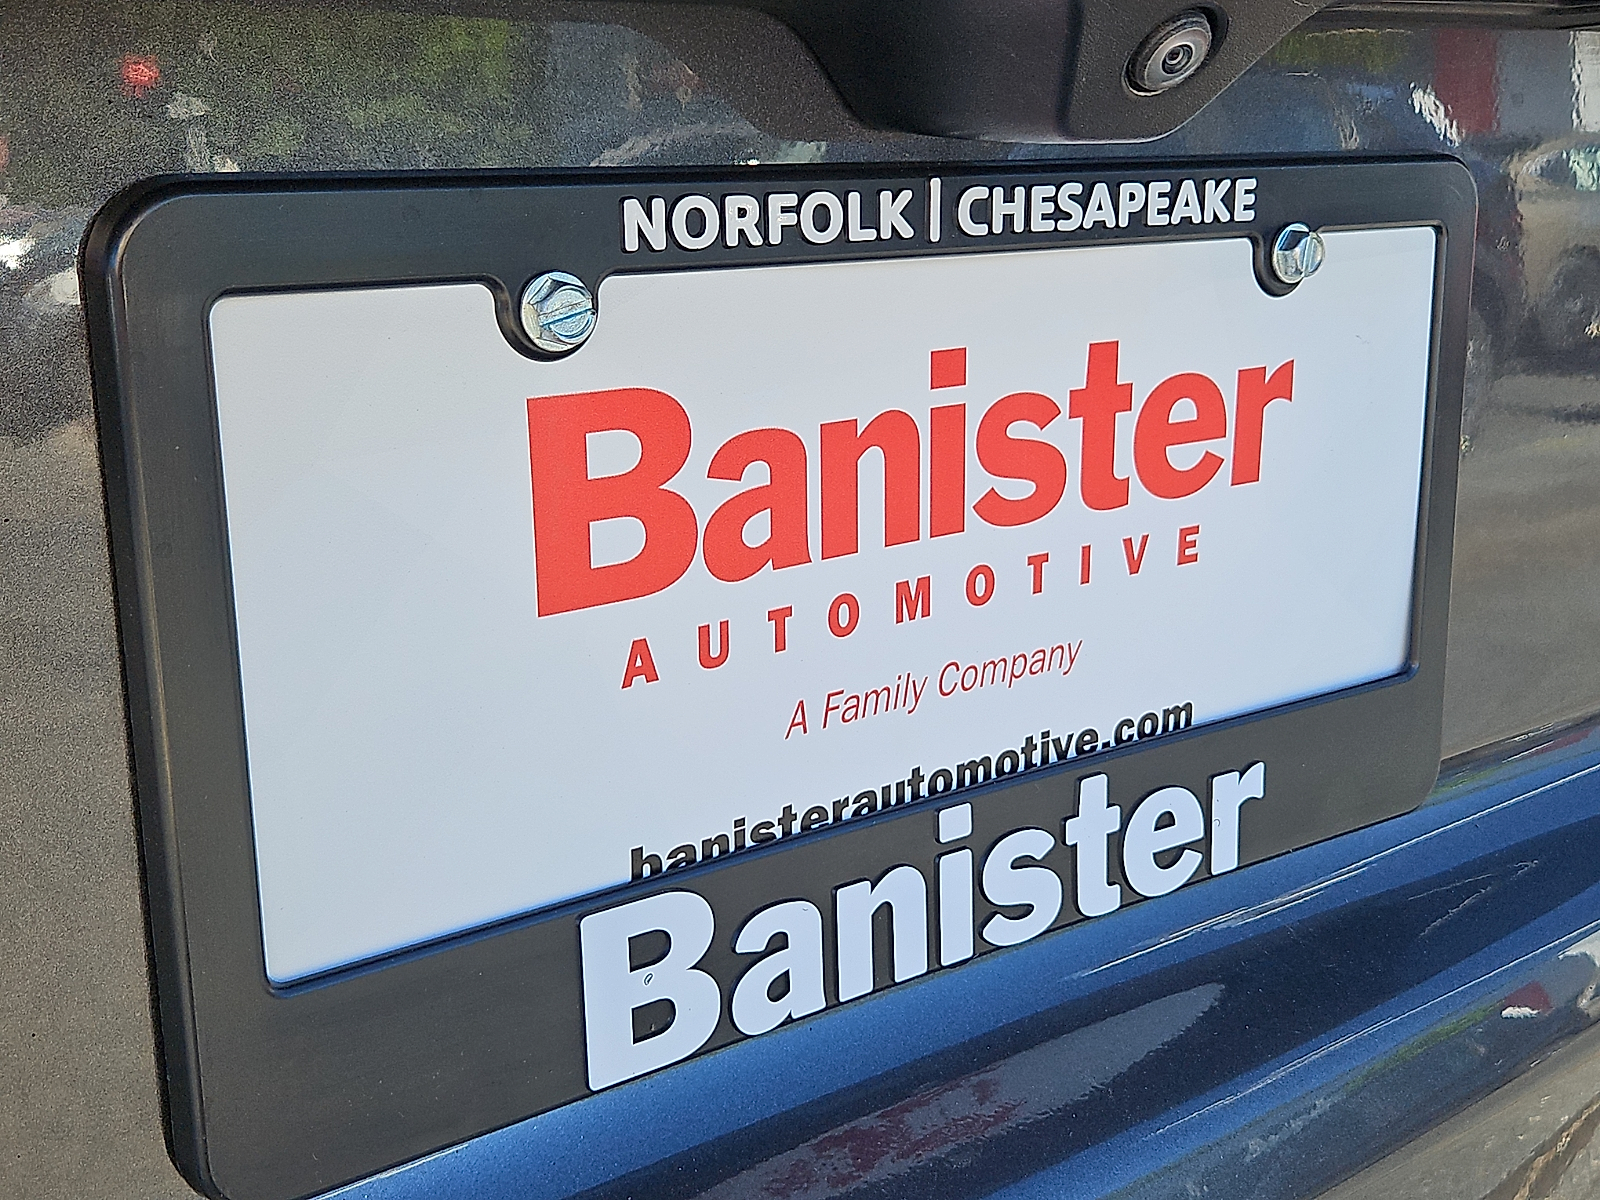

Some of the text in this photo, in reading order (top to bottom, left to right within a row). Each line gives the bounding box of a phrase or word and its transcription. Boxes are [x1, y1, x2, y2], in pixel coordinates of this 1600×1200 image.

[622, 189, 915, 253] NORFOLK
[957, 177, 1257, 237] CHESAPEAKE
[525, 339, 1295, 619] Banister
[621, 524, 1201, 690] AUTOMOTIVE
[785, 639, 1083, 740] A Family Company
[629, 702, 1194, 881] banisterautomotive.com
[579, 761, 1265, 1092] Banister
